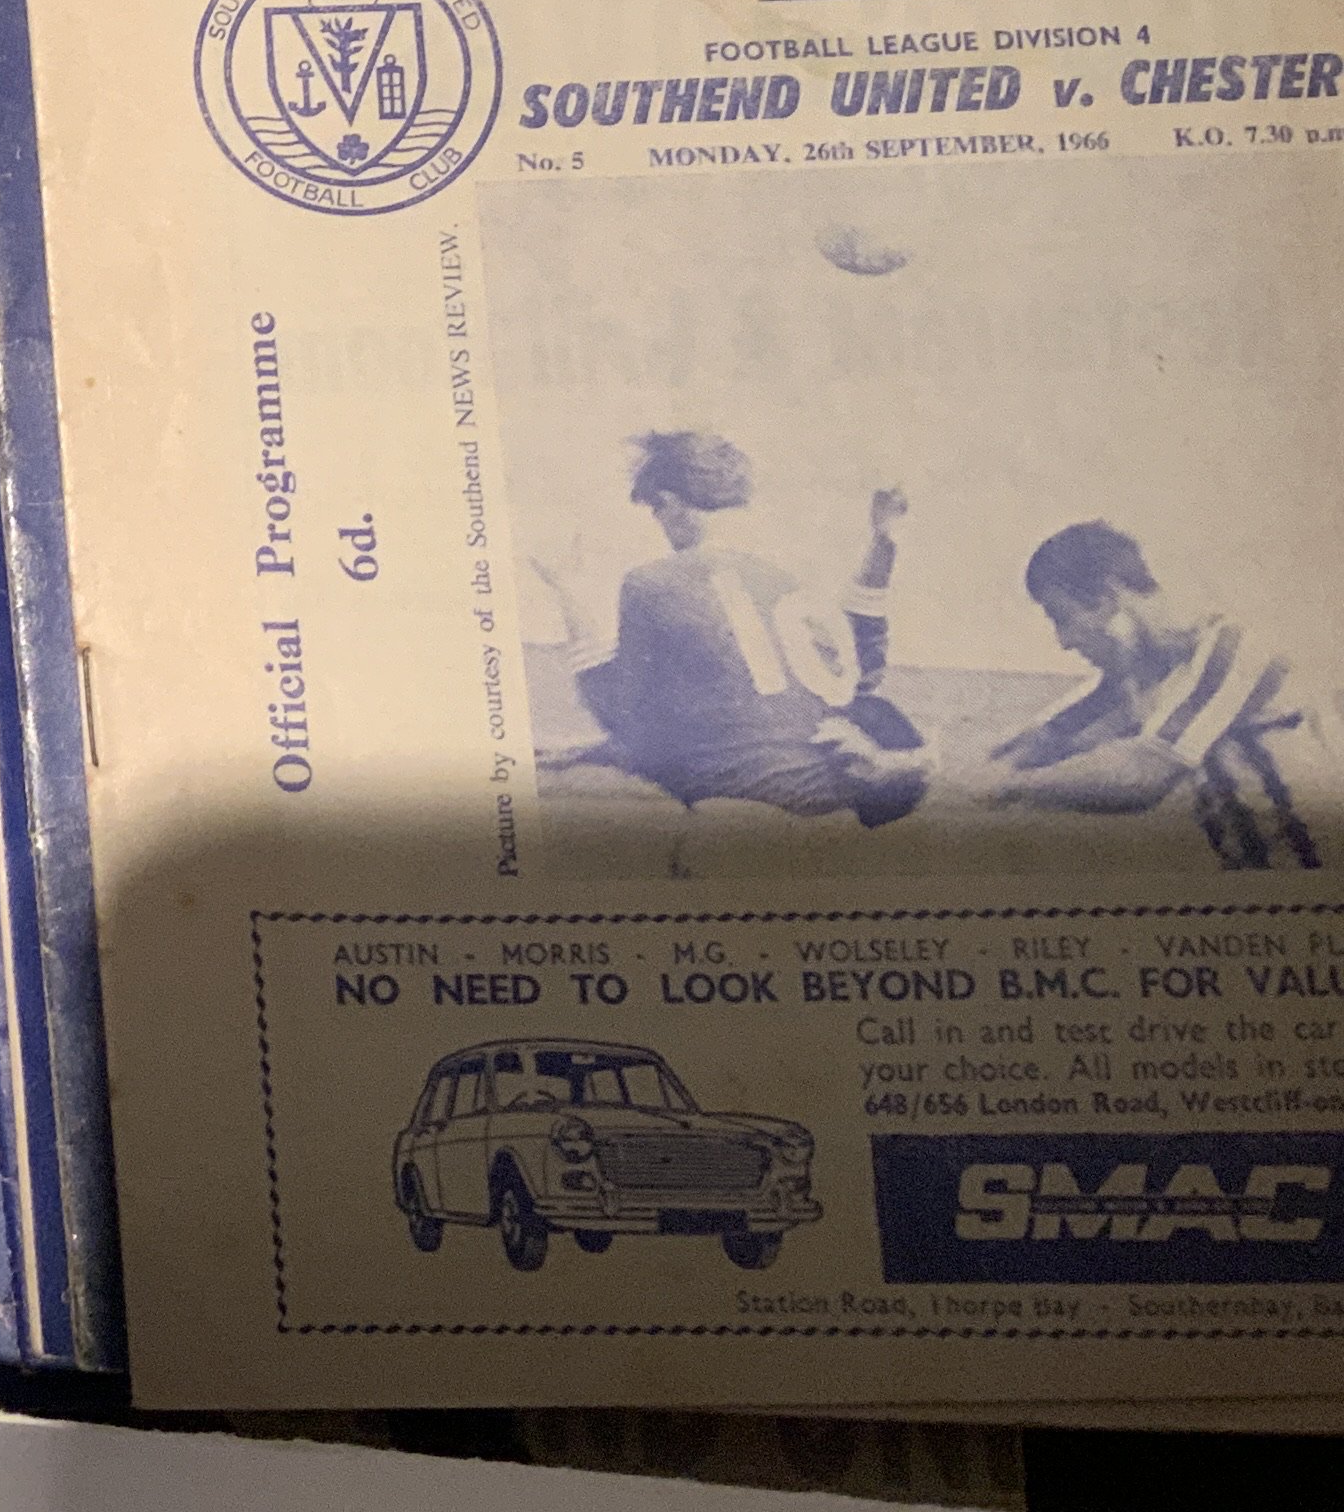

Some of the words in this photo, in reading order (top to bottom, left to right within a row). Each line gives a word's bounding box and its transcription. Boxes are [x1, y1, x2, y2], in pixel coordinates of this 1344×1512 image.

[705, 37, 853, 62] FOOTBALL
[868, 32, 979, 55] LEAGUE
[994, 26, 1120, 50] DIVISION
[1137, 25, 1150, 44] 4
[519, 75, 800, 129] SOUTHEND
[831, 66, 1021, 117] UNITED
[1054, 78, 1093, 108] v.
[1121, 53, 1344, 106] CHESTER
[572, 151, 584, 170] 5
[804, 142, 854, 161] 26th
[1058, 132, 1109, 151] 1966
[1174, 128, 1232, 147] K.O.
[1244, 125, 1293, 143] 7.30
[245, 151, 362, 207] FOOTBALL
[410, 148, 462, 190] CLUB
[440, 224, 467, 337] REVIEW.
[451, 349, 475, 427] NEWS
[252, 313, 296, 576] Programme
[459, 441, 487, 547] Southend
[338, 513, 378, 581] 6d.
[471, 560, 492, 594] the
[474, 609, 495, 633] of
[262, 619, 312, 792] Official
[483, 645, 505, 740] courtesy
[490, 756, 516, 782] by
[333, 941, 441, 966] AUSTIN
[501, 940, 612, 966] MORRIS
[795, 936, 945, 964] WOLSELEY
[1012, 935, 1092, 961] RILEY
[336, 974, 400, 1005] NO
[433, 974, 541, 1005] NEED
[570, 973, 629, 1005] TO
[661, 972, 778, 1004] LOOK
[802, 969, 976, 1002] BEYOND
[1139, 966, 1222, 999] FOR
[953, 1162, 1332, 1242] SMAC
